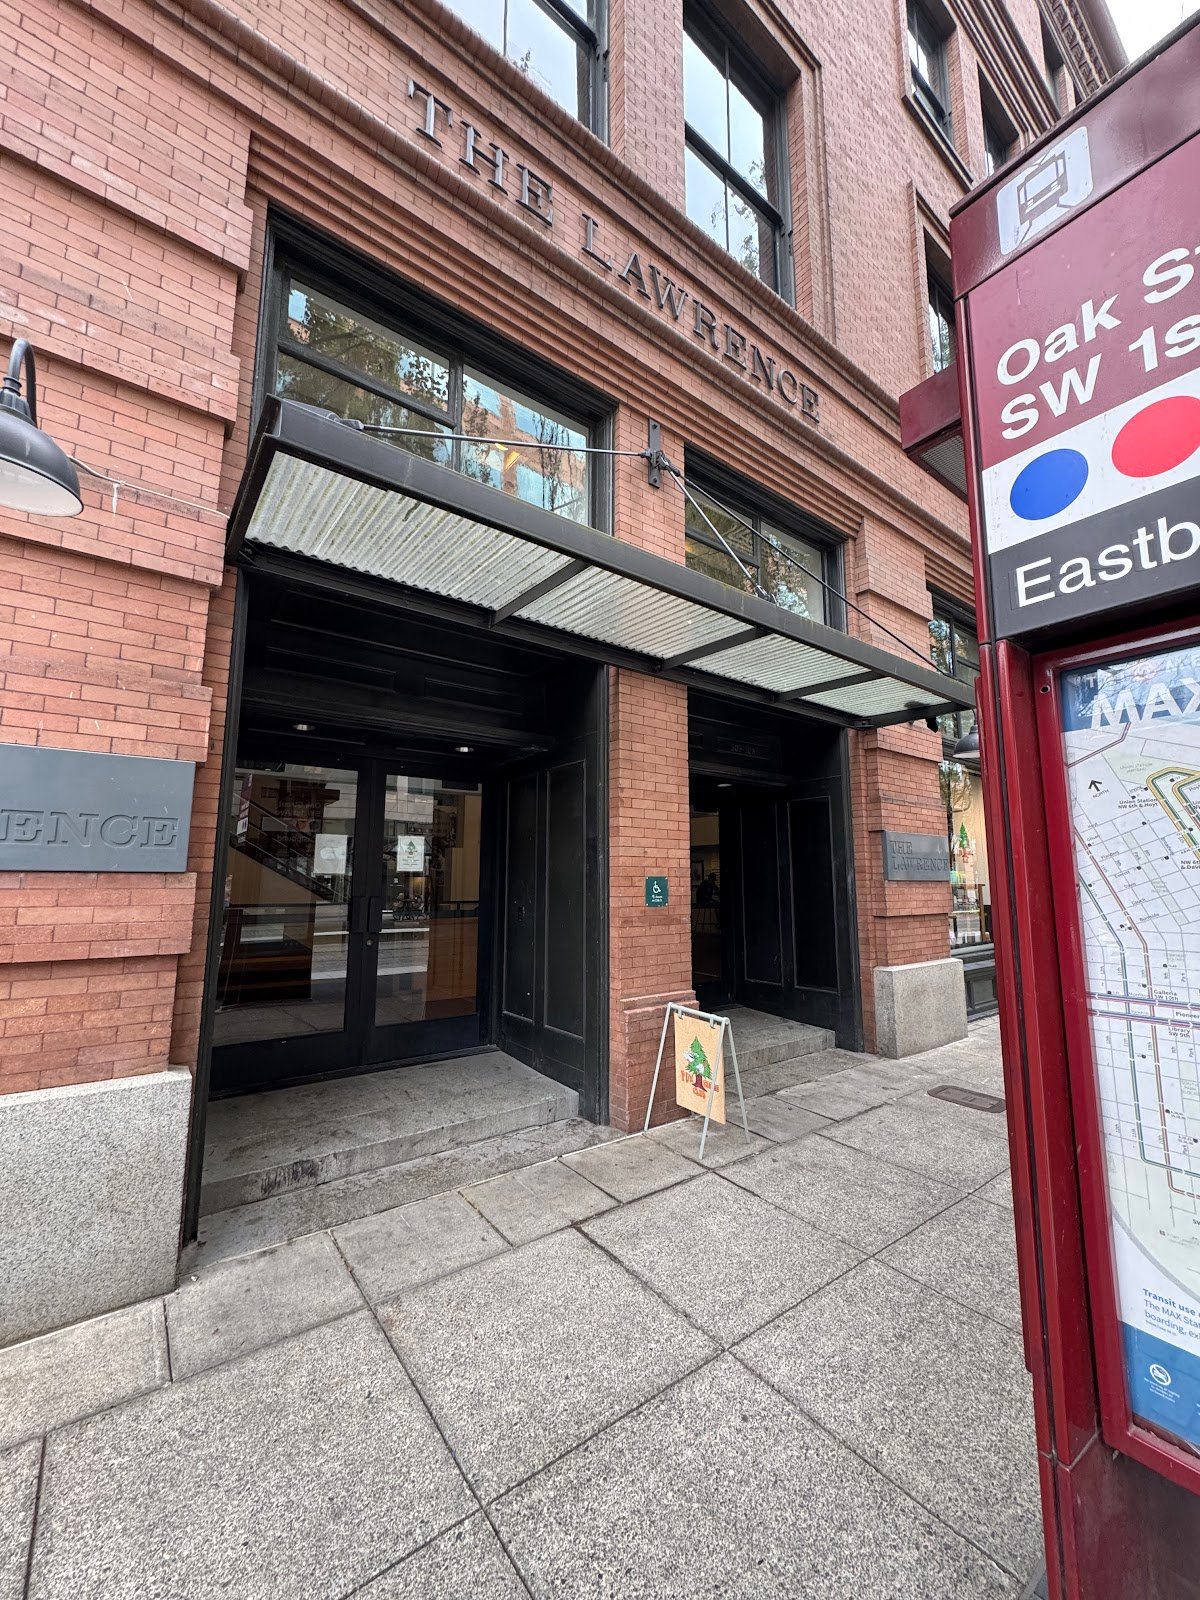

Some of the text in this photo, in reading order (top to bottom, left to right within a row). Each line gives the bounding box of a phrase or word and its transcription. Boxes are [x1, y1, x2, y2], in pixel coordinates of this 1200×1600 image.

[408, 80, 820, 424] THE LAWRENCE
[997, 246, 1200, 386] Oak S
[1001, 353, 1102, 440] SW
[1015, 516, 1200, 608] Eastb
[0, 808, 179, 850] ENCE
[889, 840, 913, 855] THE
[892, 856, 949, 872] LAWRENCE
[1168, 1026, 1191, 1034] Library
[1142, 1287, 1196, 1316] Transit use
[1143, 1298, 1161, 1312] The
[1161, 1306, 1182, 1322] MAX
[1144, 1309, 1187, 1336] boarding,
